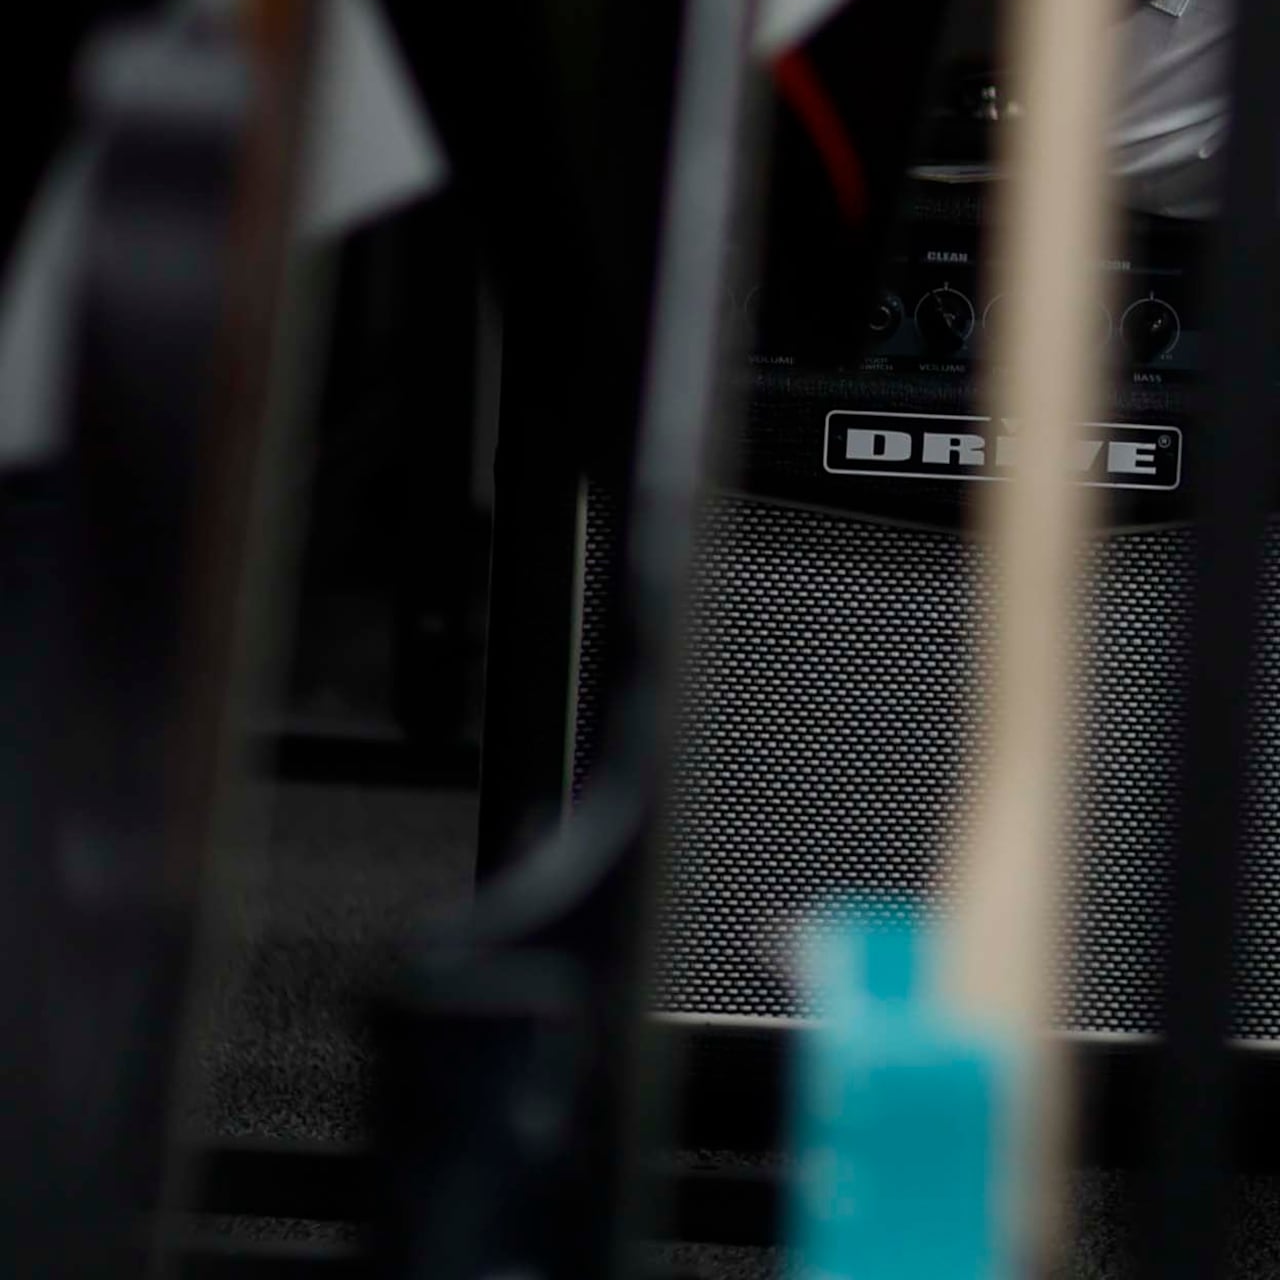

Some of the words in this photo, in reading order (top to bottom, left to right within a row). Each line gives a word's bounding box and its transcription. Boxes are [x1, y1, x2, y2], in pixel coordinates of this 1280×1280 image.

[927, 251, 968, 264] CLEAN
[919, 363, 967, 373] VOLUME
[1133, 371, 1163, 384] BASS
